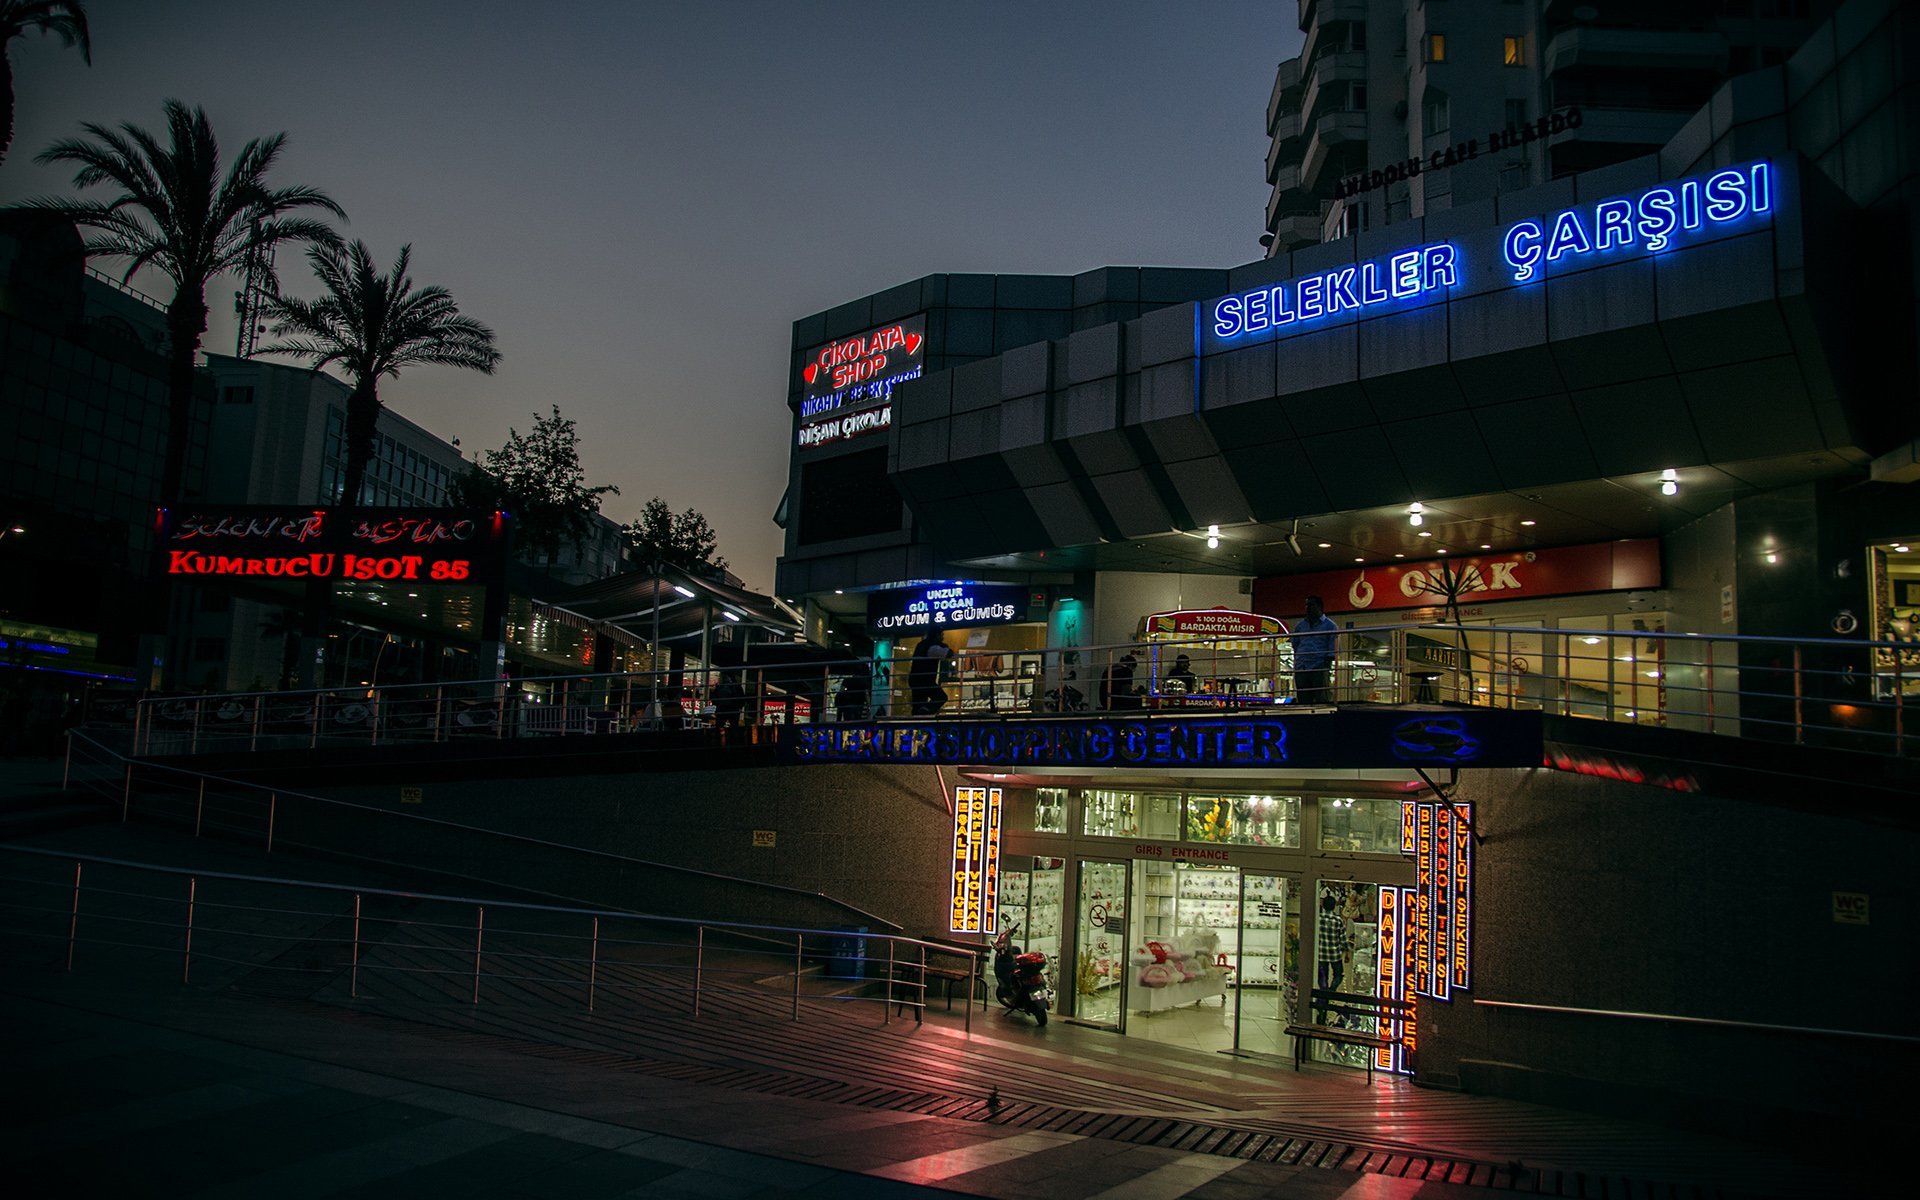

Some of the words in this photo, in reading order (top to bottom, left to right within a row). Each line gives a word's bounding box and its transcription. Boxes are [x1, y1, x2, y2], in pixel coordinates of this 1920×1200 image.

[1335, 156, 1420, 200] ANADOLU
[1431, 140, 1477, 170] CAFE
[1214, 244, 1457, 337] SELEKLER
[1504, 161, 1771, 281] ÇARŞISI
[818, 325, 905, 374] ÇİKOLATA
[832, 354, 887, 389] SHOP
[799, 422, 840, 445] NİŞAN
[842, 406, 892, 438] ÇİKOLA
[801, 394, 834, 417] NİKAH
[927, 587, 963, 600] UNZUR
[934, 611, 946, 623] &
[951, 603, 1015, 620] GÜMÜŞ
[1180, 623, 1228, 633] BARDAKTA
[1229, 624, 1255, 633] MISIR
[797, 724, 936, 760] SELEKLER
[938, 724, 1114, 762] SHOPPING
[1118, 722, 1287, 762] CENTER
[755, 832, 773, 840] WC
[1403, 803, 1414, 849] KINA
[1419, 809, 1430, 885] BEBEK
[1172, 847, 1229, 860] ENTRANCE
[1437, 809, 1449, 904] GONDOL
[967, 871, 980, 930] VOLKAN
[1836, 895, 1865, 910] WC
[1418, 895, 1430, 991] ŞEKERİ
[1436, 915, 1448, 995] TEPSİ
[1454, 898, 1467, 985] ŞEKERİ
